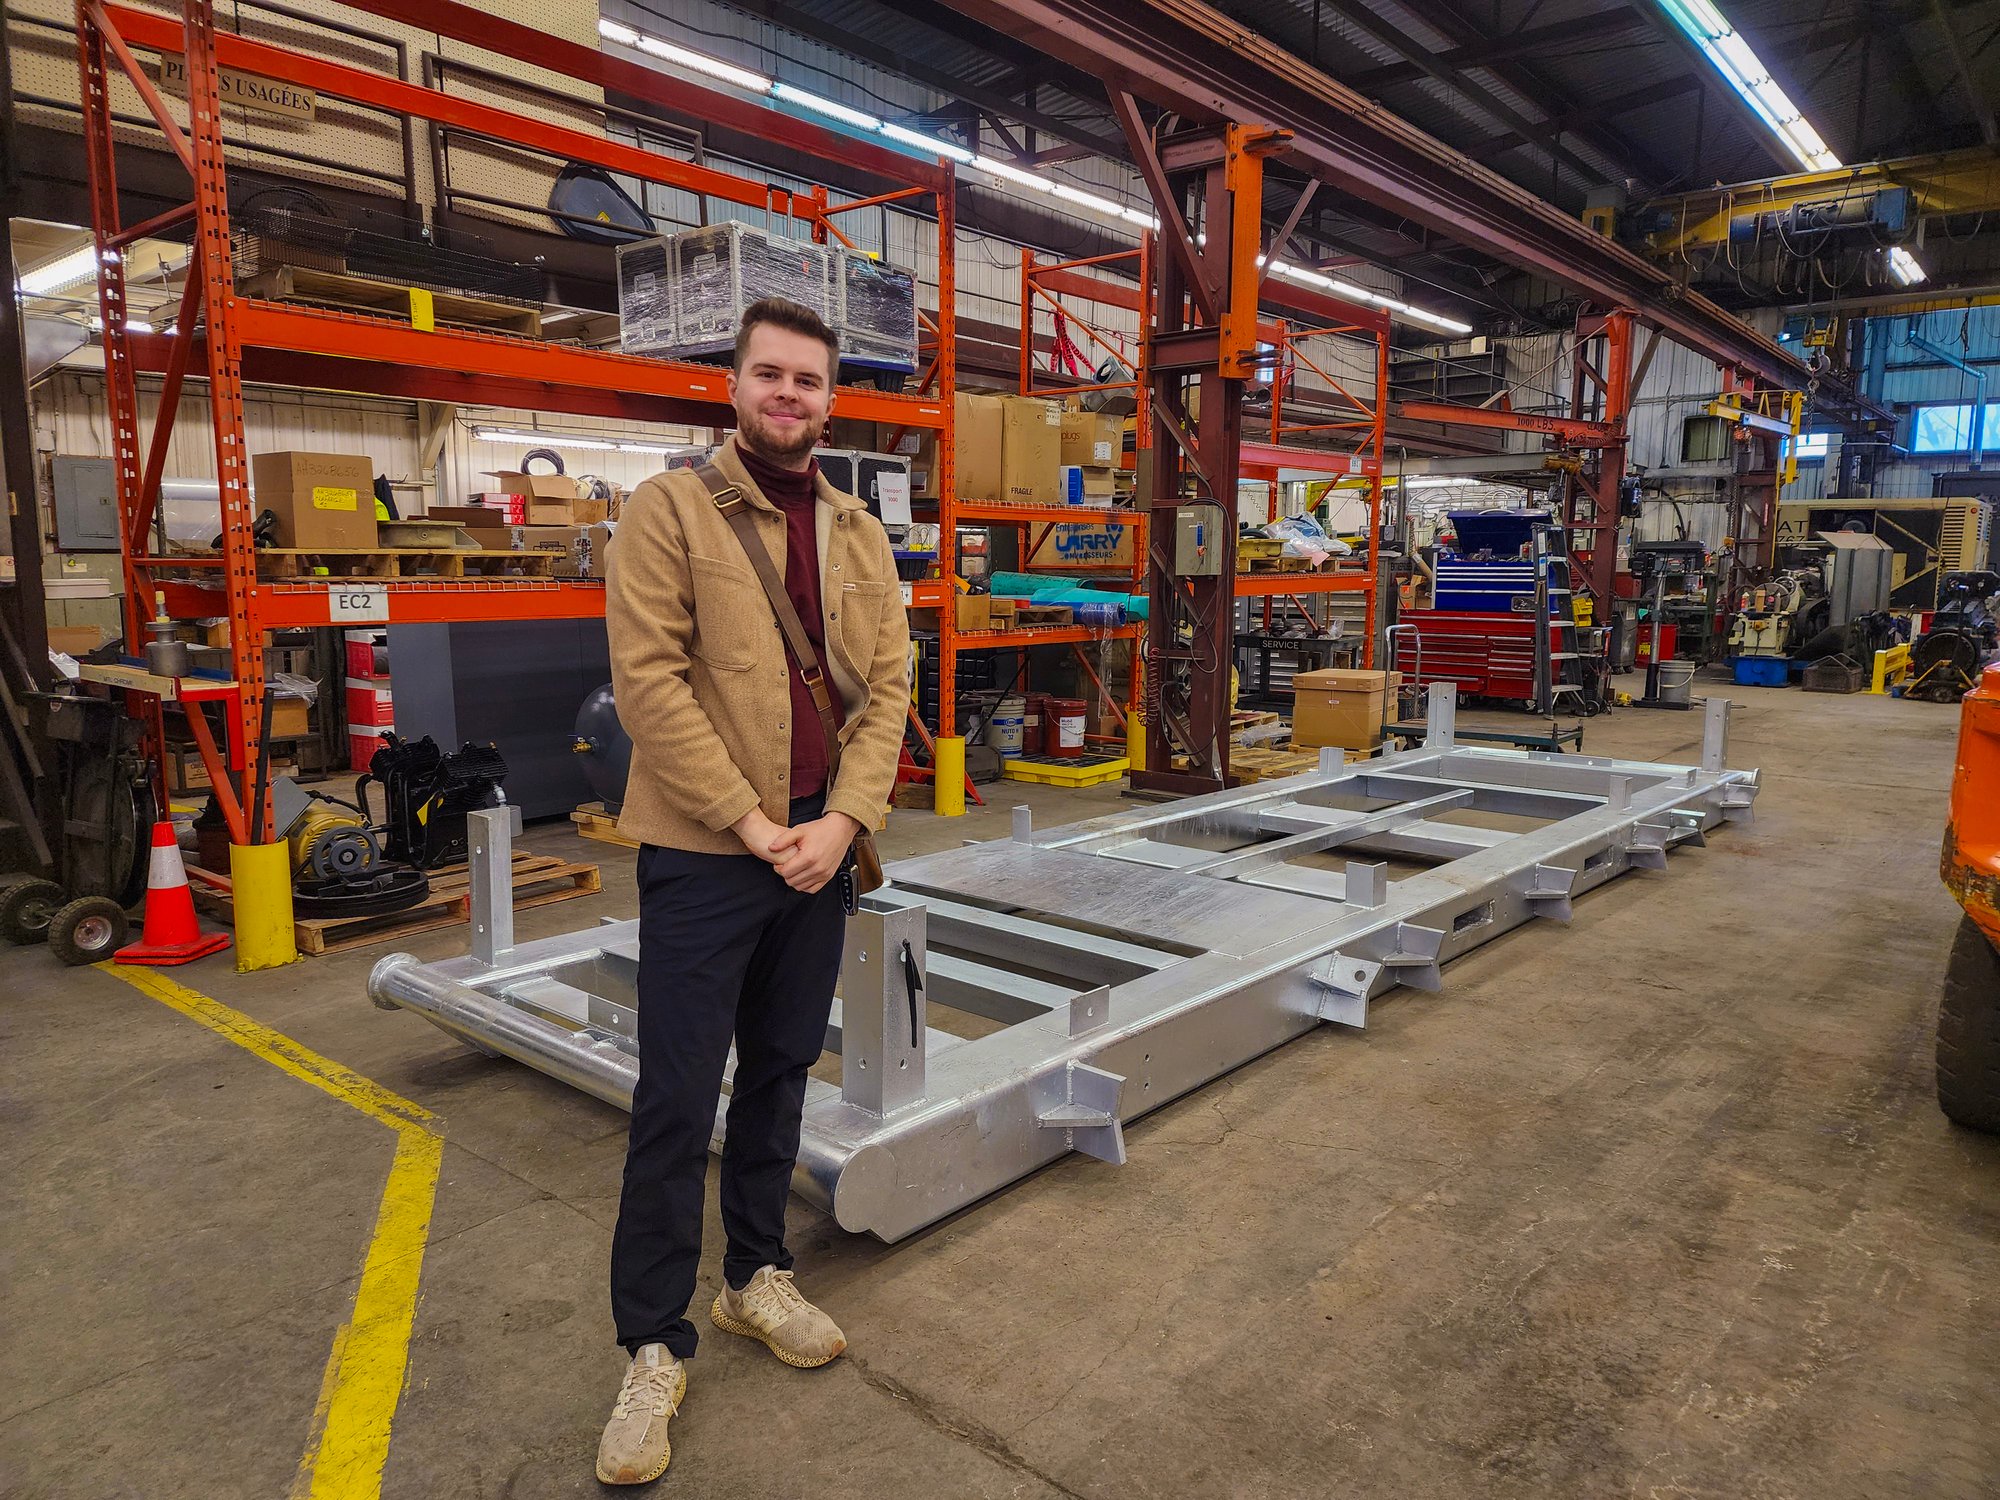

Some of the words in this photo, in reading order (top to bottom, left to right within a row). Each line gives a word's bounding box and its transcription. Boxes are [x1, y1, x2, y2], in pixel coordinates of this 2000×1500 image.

[166, 61, 231, 92] PIS
[235, 78, 311, 112] USAGÉES
[1517, 417, 1535, 429] 1000
[1536, 420, 1556, 431] LBS.
[1011, 487, 1033, 496] FRAGILE
[339, 594, 372, 609] EC2
[1262, 640, 1300, 650] SERVICE
